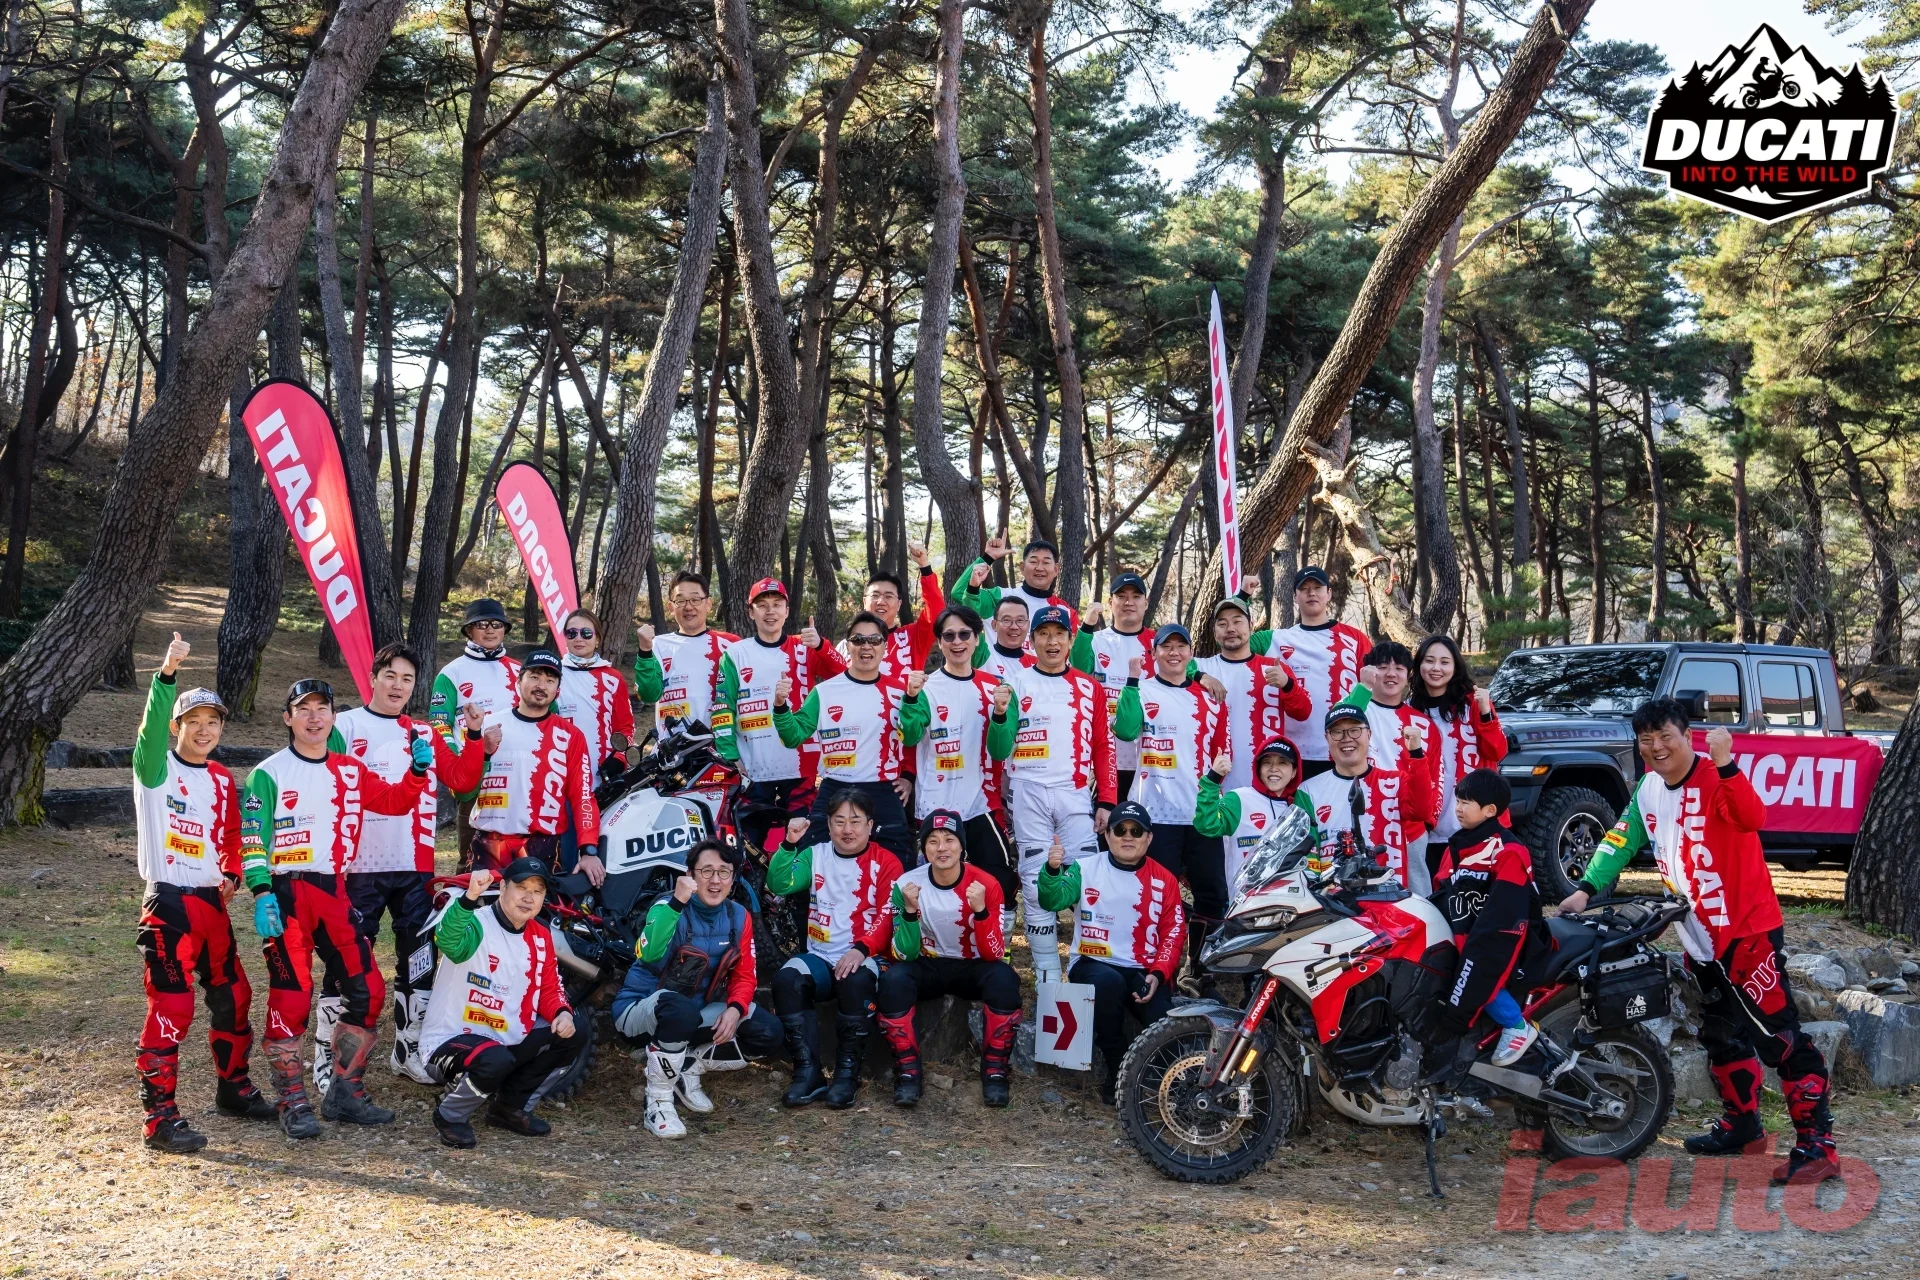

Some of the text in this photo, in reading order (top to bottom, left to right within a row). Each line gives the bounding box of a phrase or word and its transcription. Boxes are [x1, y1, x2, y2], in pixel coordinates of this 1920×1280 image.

[506, 491, 570, 633] DUCAT
[533, 654, 559, 665] DUCATI
[1075, 676, 1095, 776] DUCAT
[1329, 708, 1357, 718] DUCATI
[1526, 729, 1618, 740] RUBICON
[537, 726, 572, 835] DUCAT
[1694, 751, 1857, 808] CATI
[582, 799, 593, 829] KORE
[626, 826, 704, 859] DUCA
[1377, 777, 1404, 886] DUCA
[1451, 868, 1489, 886] DUCATI
[986, 930, 1005, 959] OREA
[1028, 925, 1054, 935] THOR
[1082, 927, 1107, 940] OTUL
[1450, 958, 1474, 1007] DUCATI
[1742, 951, 1780, 1005] DUC
[1626, 1006, 1647, 1017] HAS
